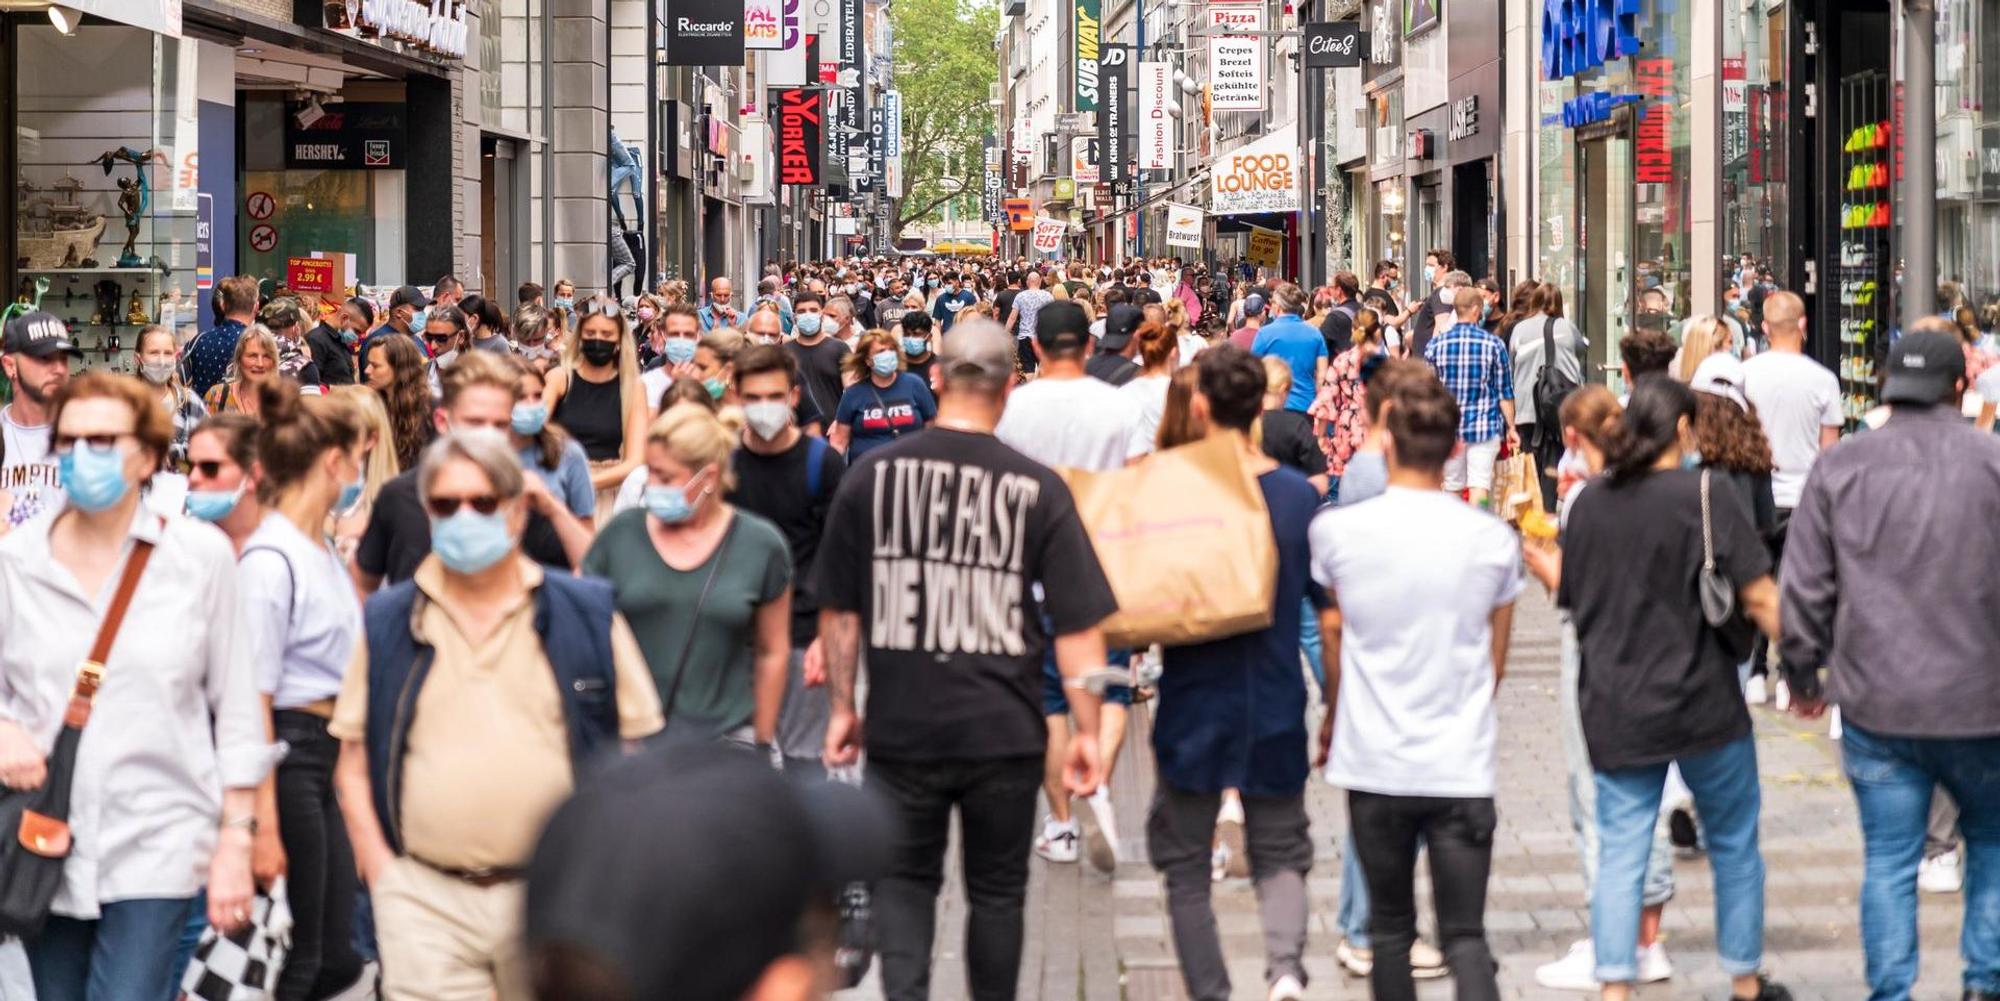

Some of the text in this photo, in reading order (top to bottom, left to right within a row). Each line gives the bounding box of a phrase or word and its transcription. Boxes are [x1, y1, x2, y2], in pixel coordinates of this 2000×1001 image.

[1215, 12, 1256, 23] Pizza
[1078, 6, 1099, 104] SUBWAY
[1102, 48, 1125, 66] JD
[1218, 46, 1253, 55] Crepes
[1219, 58, 1251, 66] Brezel
[1218, 70, 1253, 78] Softeis
[1213, 81, 1258, 91] gekühlte
[1109, 76, 1118, 126] TRAINERS
[1212, 93, 1260, 103] Getränke
[1152, 68, 1164, 168] Fashion Discount
[872, 110, 883, 174] HOTEL
[1109, 138, 1118, 163] KING
[1233, 154, 1290, 174] FOOD
[1217, 171, 1293, 192] LOUNGE
[1036, 221, 1062, 235] SOFT
[1168, 230, 1200, 242] Bratwurst
[1035, 235, 1060, 248] EIS
[297, 272, 315, 282] 2.99
[872, 458, 1040, 573] LIVE FAST
[871, 558, 1026, 656] DIE YOUNG
